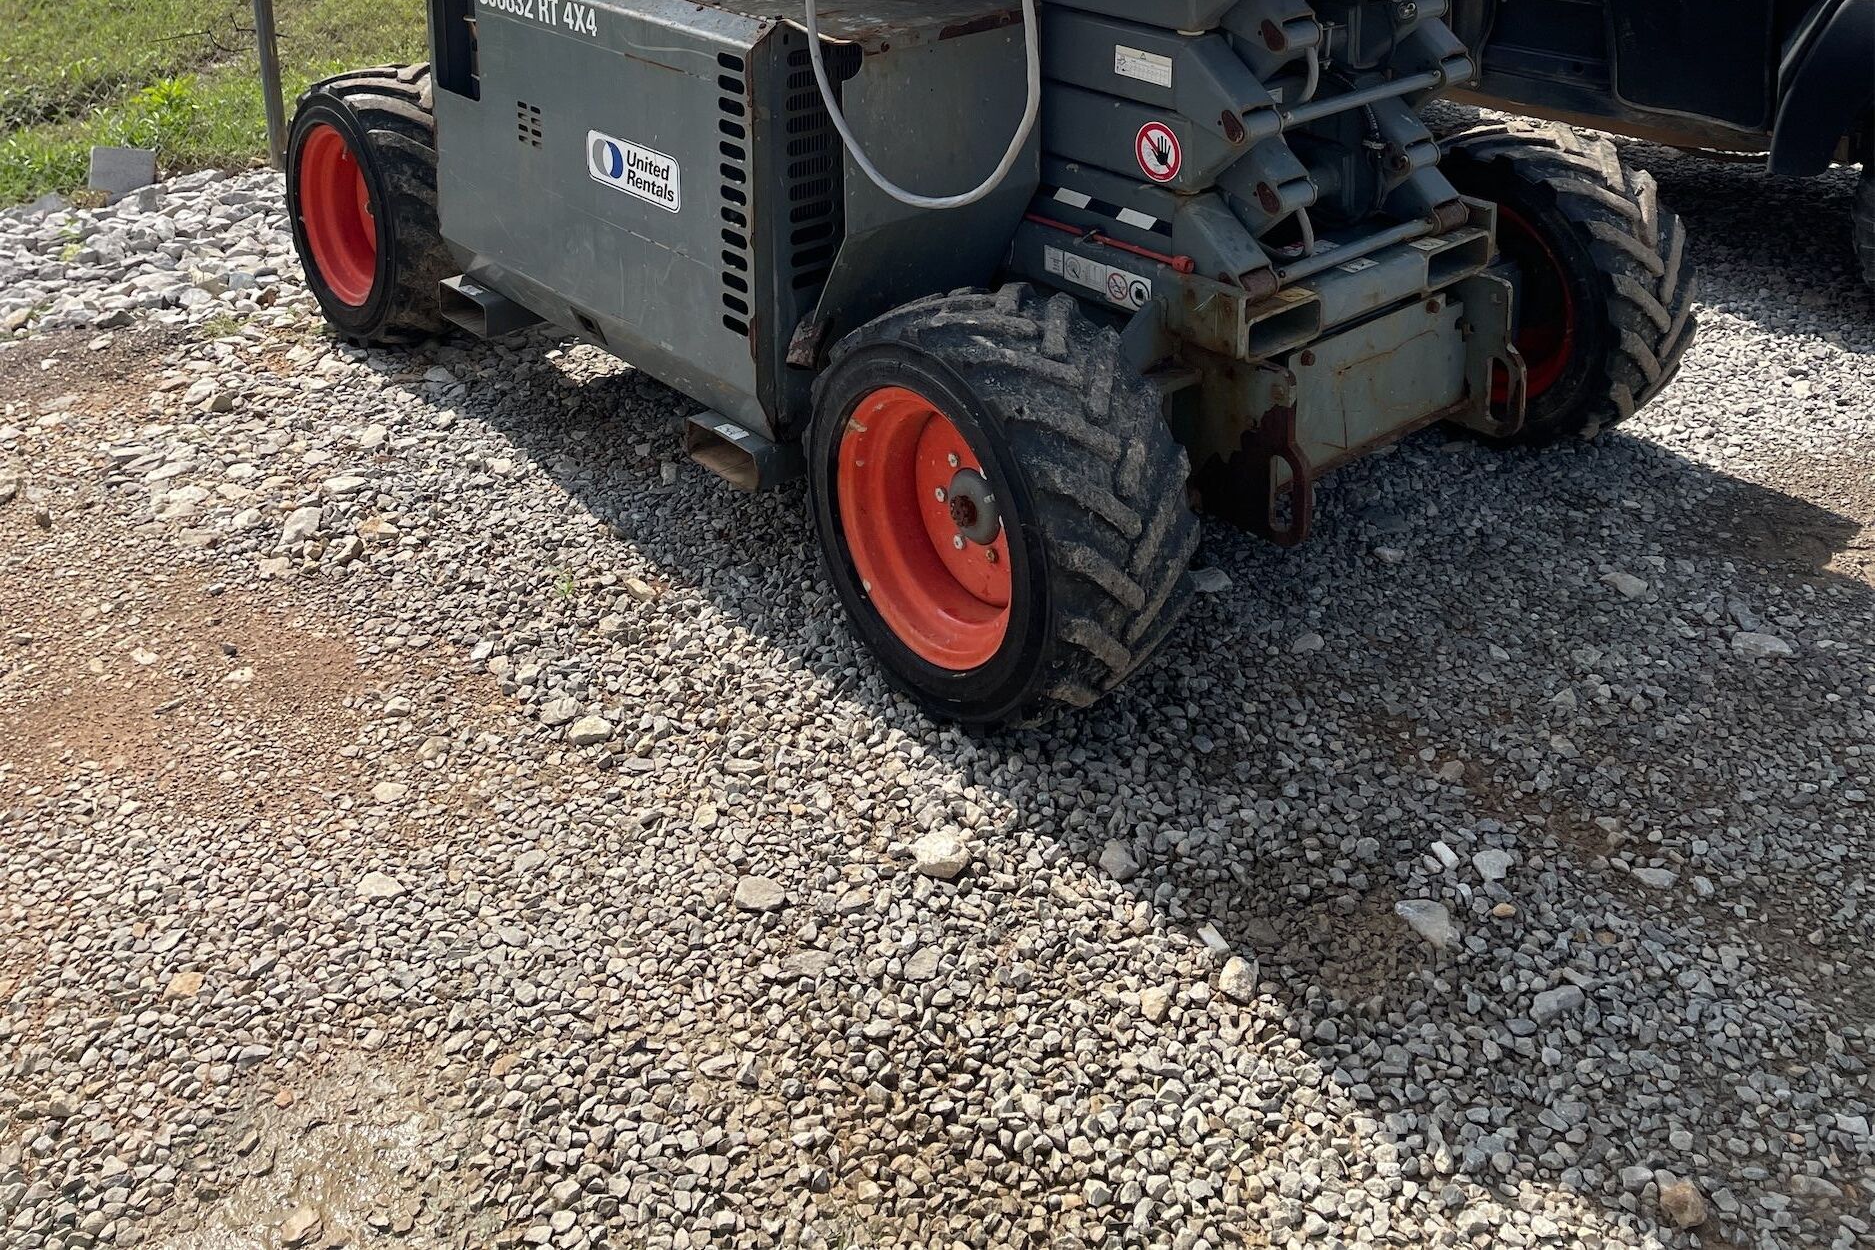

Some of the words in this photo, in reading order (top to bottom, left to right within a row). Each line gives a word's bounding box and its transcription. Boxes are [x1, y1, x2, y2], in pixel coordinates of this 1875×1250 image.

[563, 3, 598, 37] 4X4
[626, 149, 670, 182] United
[627, 168, 675, 203] Rentals
